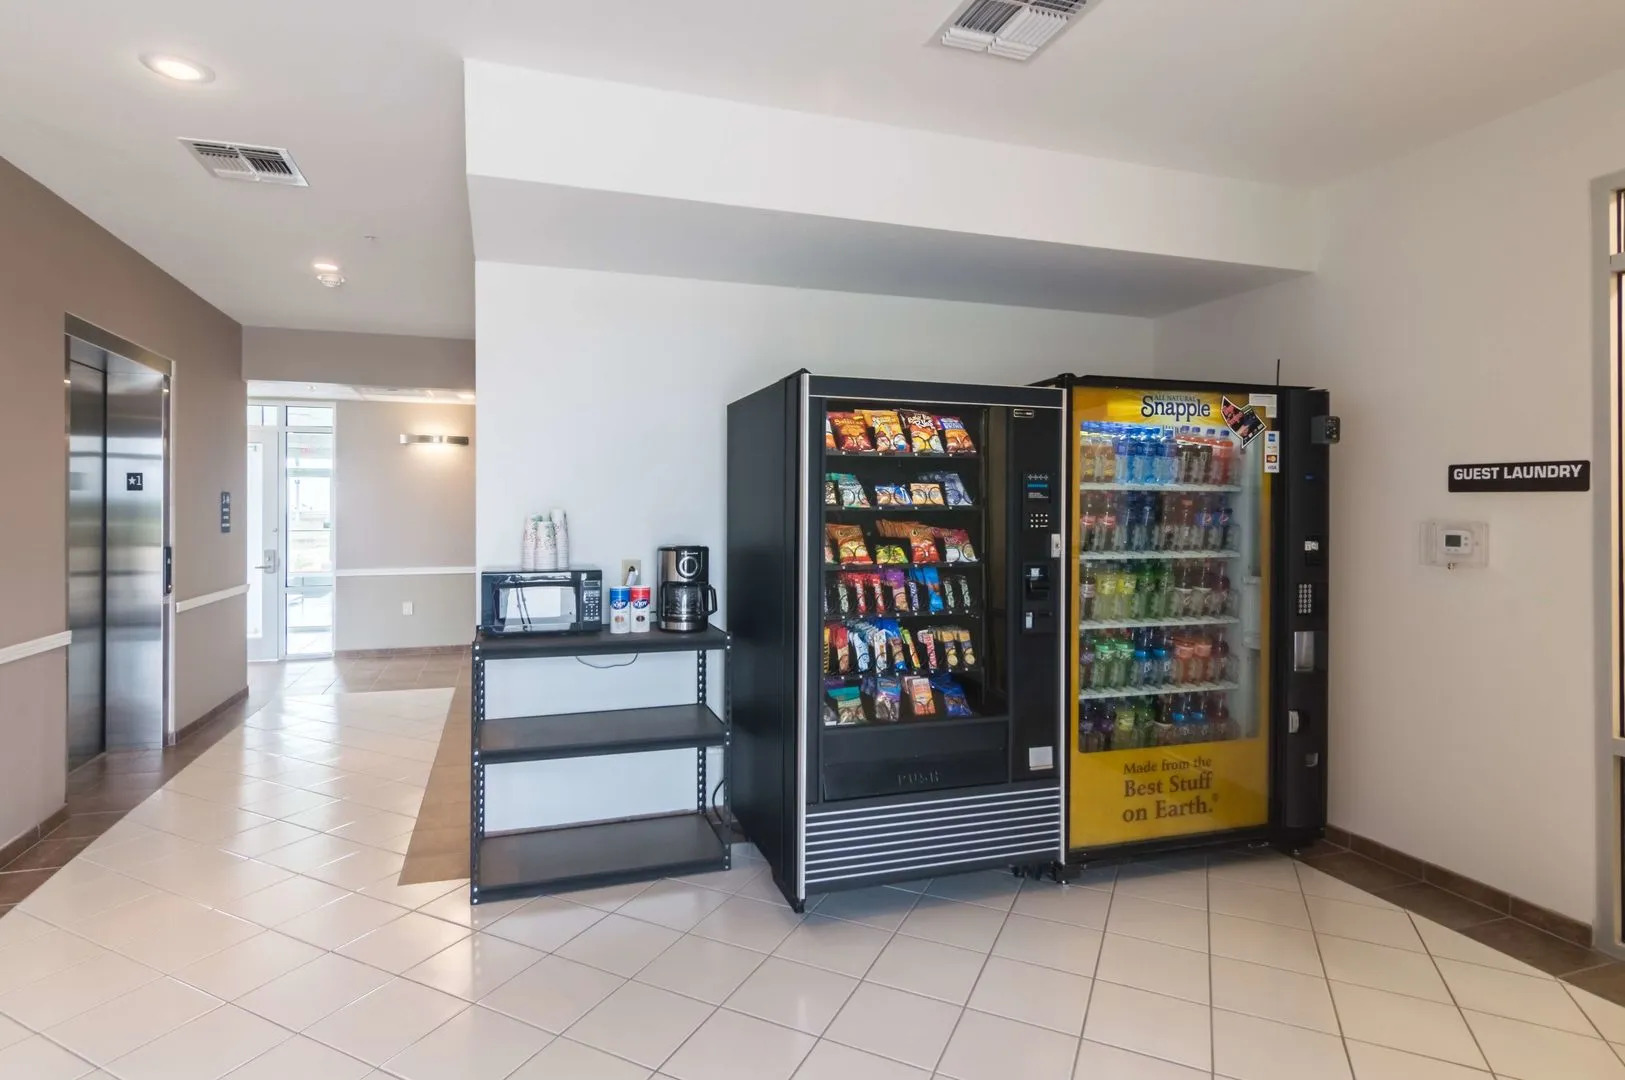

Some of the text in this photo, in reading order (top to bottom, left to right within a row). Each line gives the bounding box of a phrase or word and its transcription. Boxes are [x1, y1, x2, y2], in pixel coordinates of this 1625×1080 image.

[1141, 395, 1211, 422] Snapple
[1453, 464, 1582, 480] GUEST LAUNDRY
[1124, 756, 1212, 774] Made from the
[1124, 771, 1213, 797] Best Stuff
[1122, 807, 1148, 822] on
